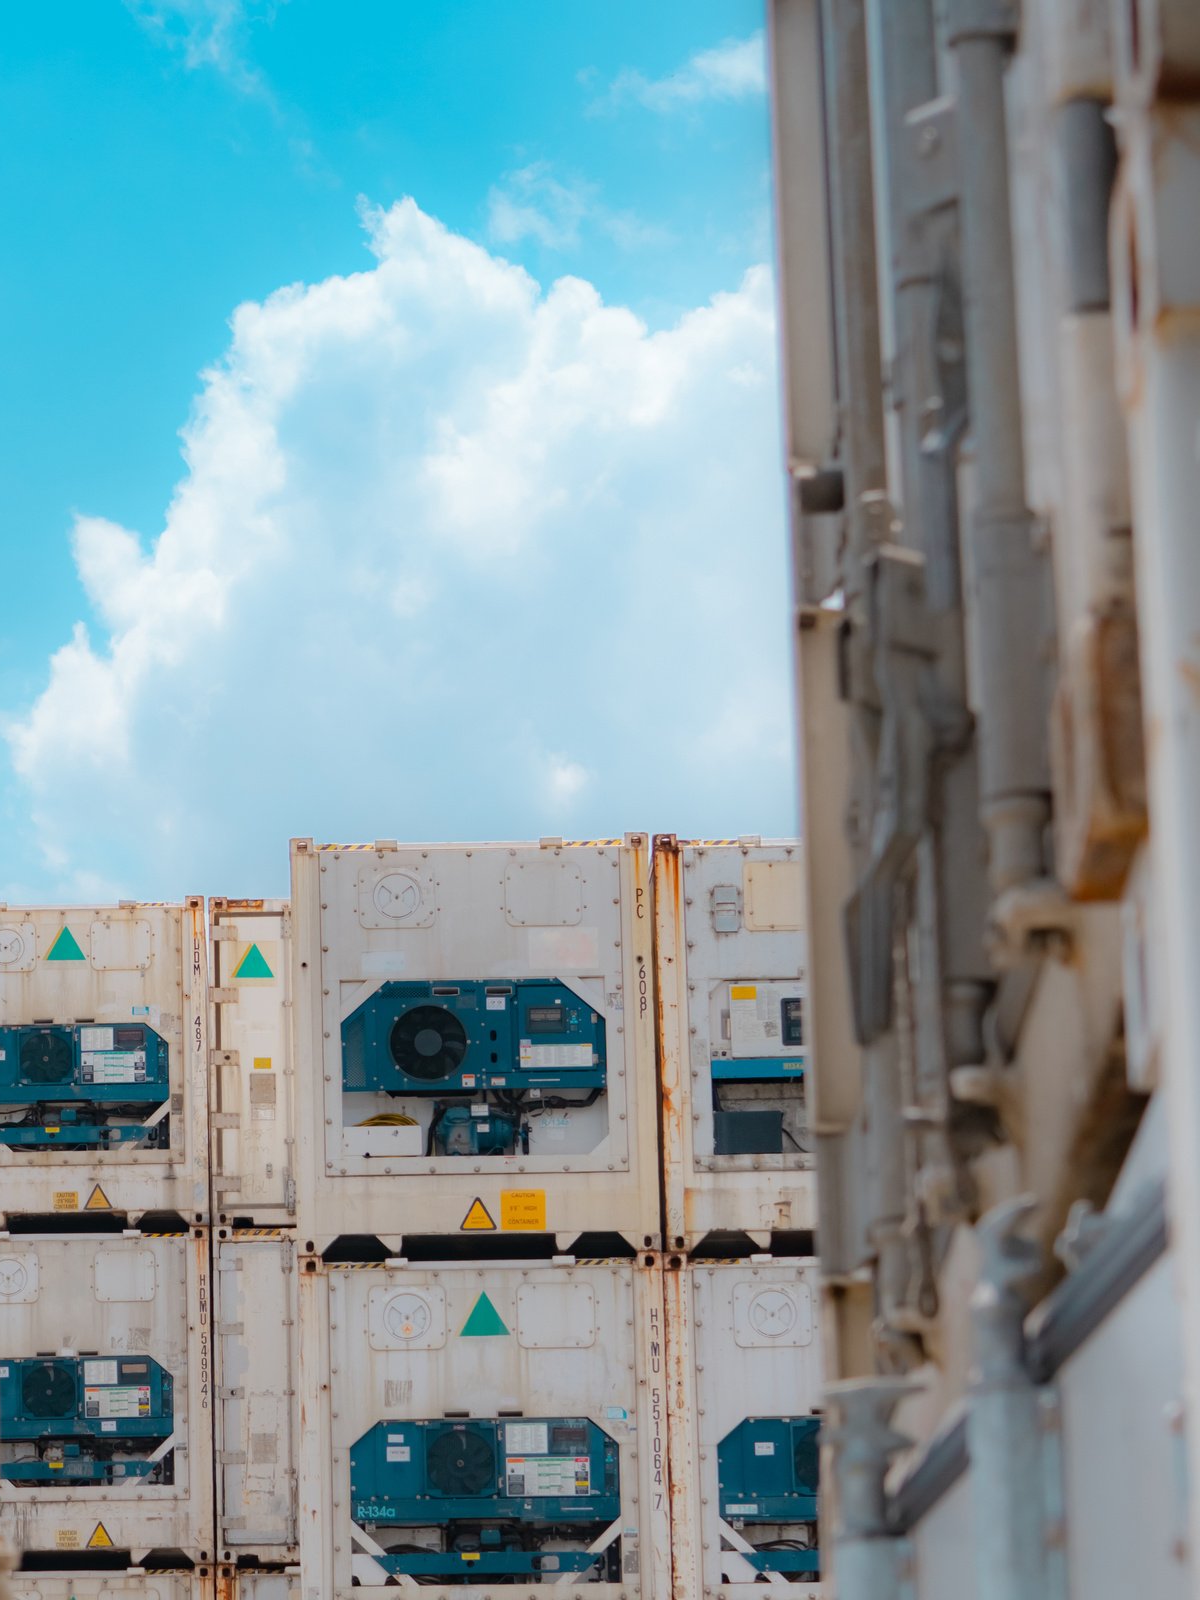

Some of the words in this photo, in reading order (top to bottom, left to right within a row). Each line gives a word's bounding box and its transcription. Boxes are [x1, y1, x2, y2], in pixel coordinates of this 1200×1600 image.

[194, 1015, 202, 1052] 487
[199, 1274, 208, 1326] HDMU
[200, 1332, 208, 1409] 549046
[652, 1388, 662, 1486] 551064
[357, 1505, 396, 1518] R-134a
[655, 1494, 663, 1510] 7
